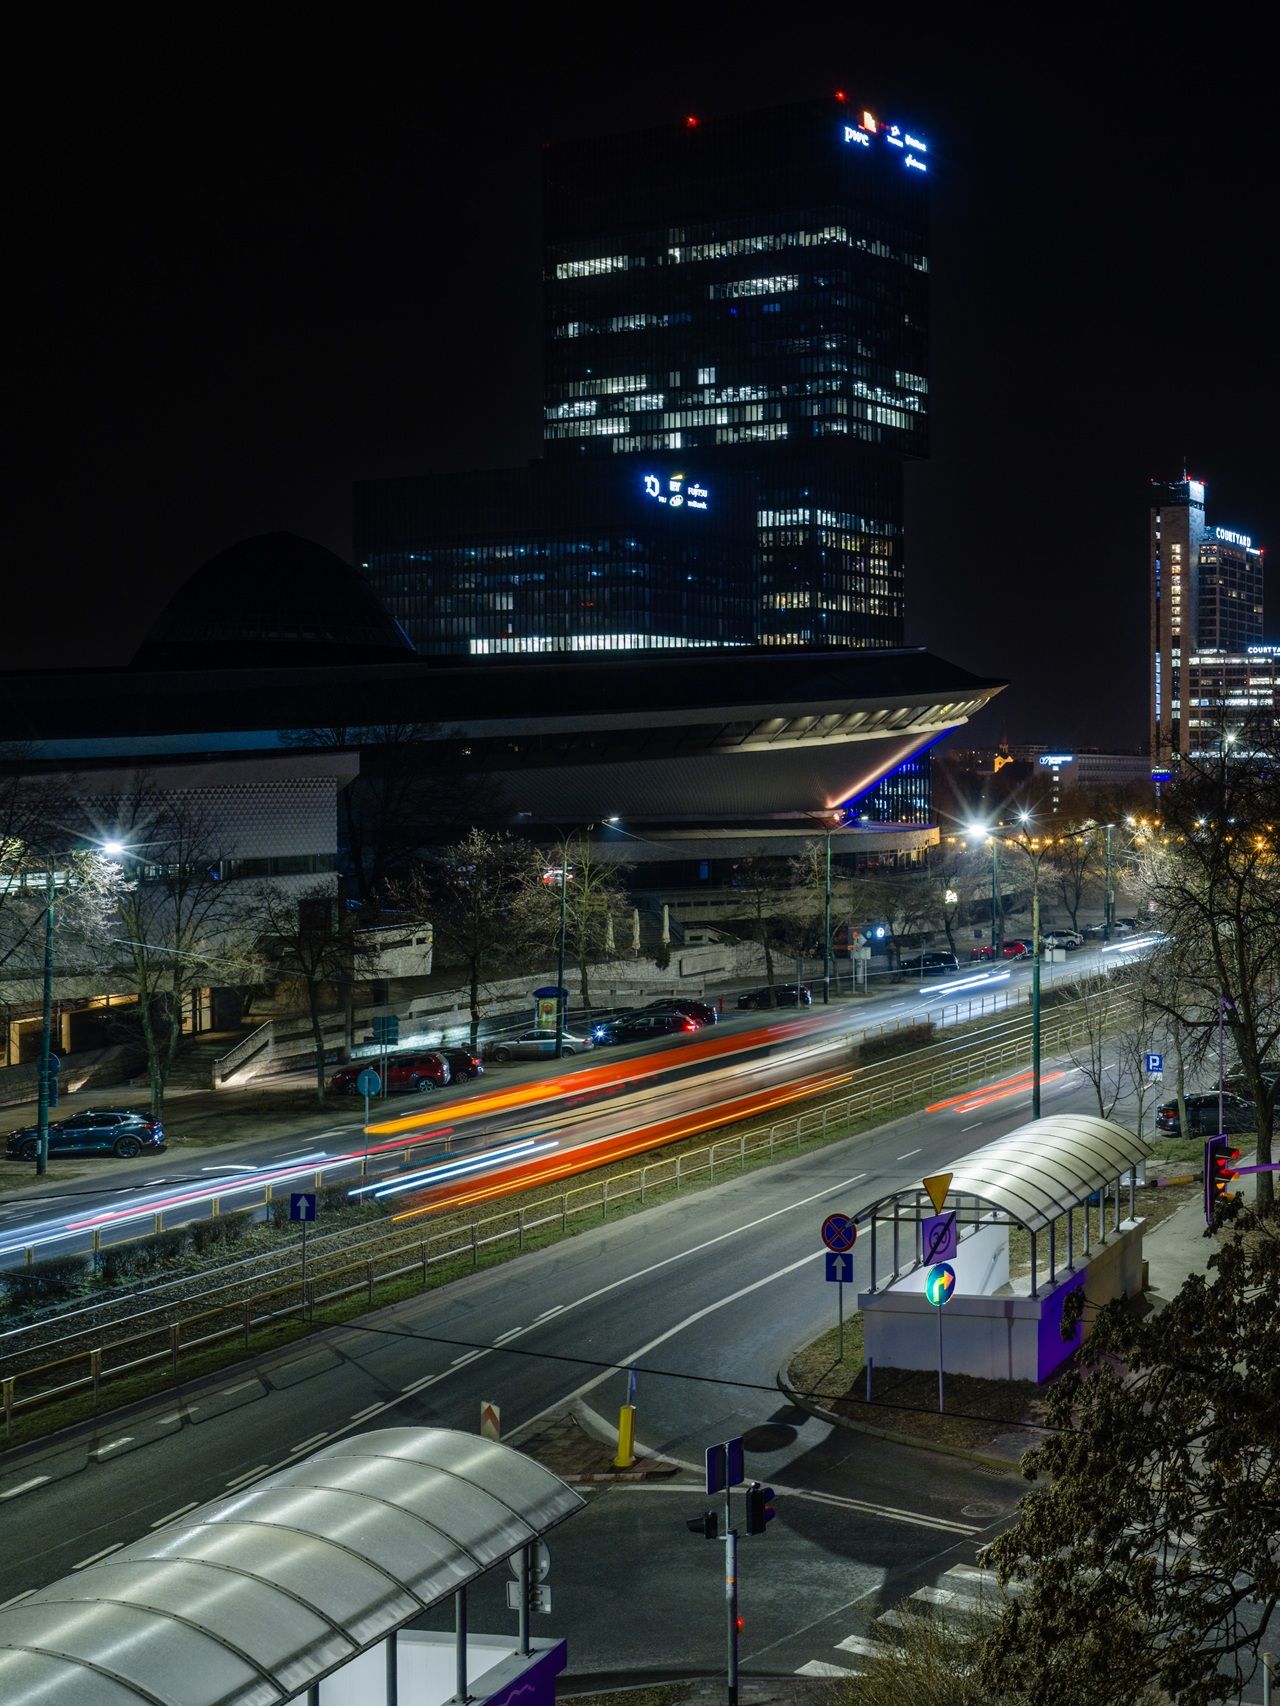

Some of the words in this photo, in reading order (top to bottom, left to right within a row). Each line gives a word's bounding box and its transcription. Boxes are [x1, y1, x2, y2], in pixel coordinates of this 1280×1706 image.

[845, 127, 870, 147] pwc
[1216, 527, 1251, 547] COURTYARD
[1149, 1055, 1160, 1070] P
